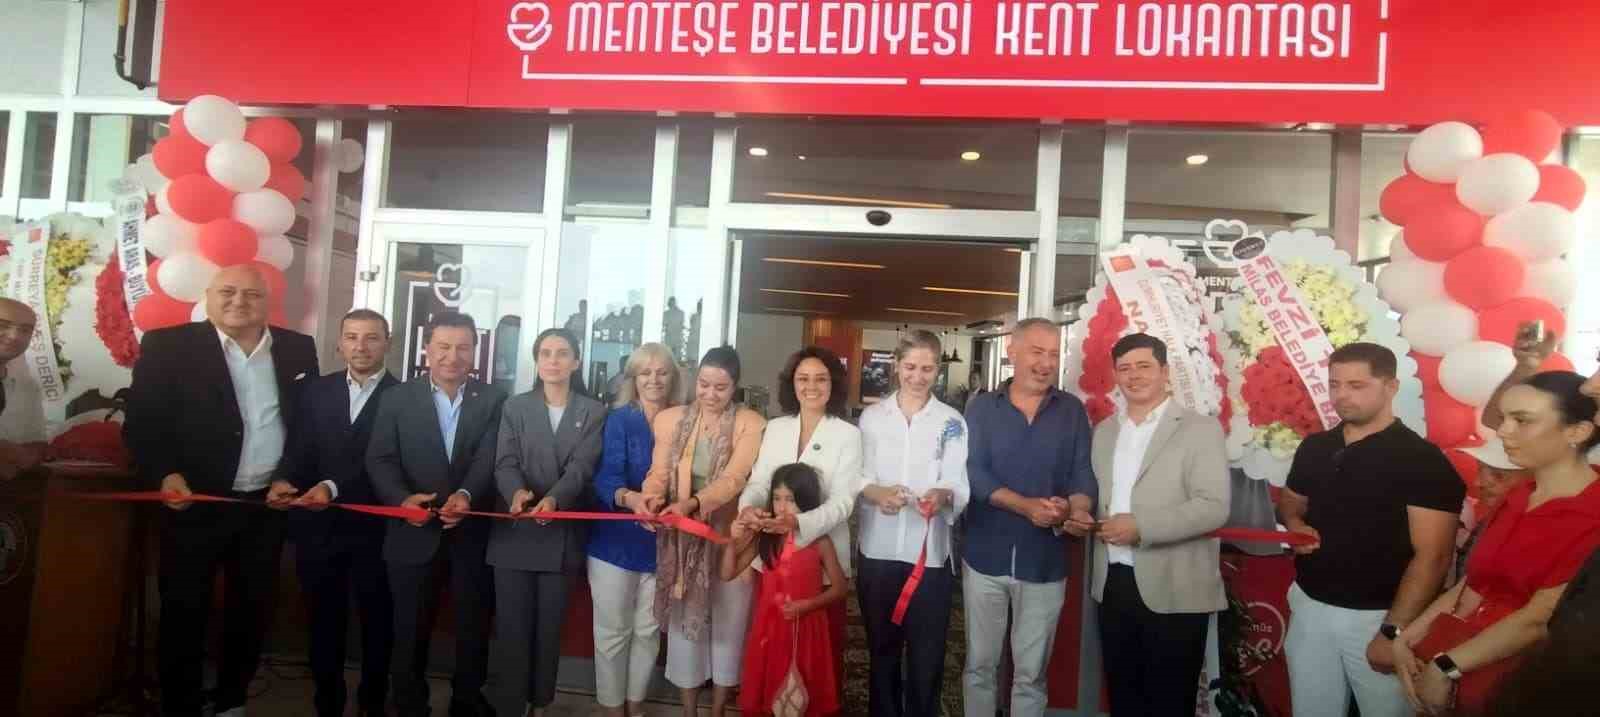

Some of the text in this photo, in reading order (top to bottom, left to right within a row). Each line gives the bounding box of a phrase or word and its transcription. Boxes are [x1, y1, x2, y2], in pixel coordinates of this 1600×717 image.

[566, 0, 1352, 58] MENTEŞE BELEDİYESİ KENT LOKANTASI
[1239, 263, 1273, 307] MİLAS
[1266, 309, 1327, 396] BELEDİYE
